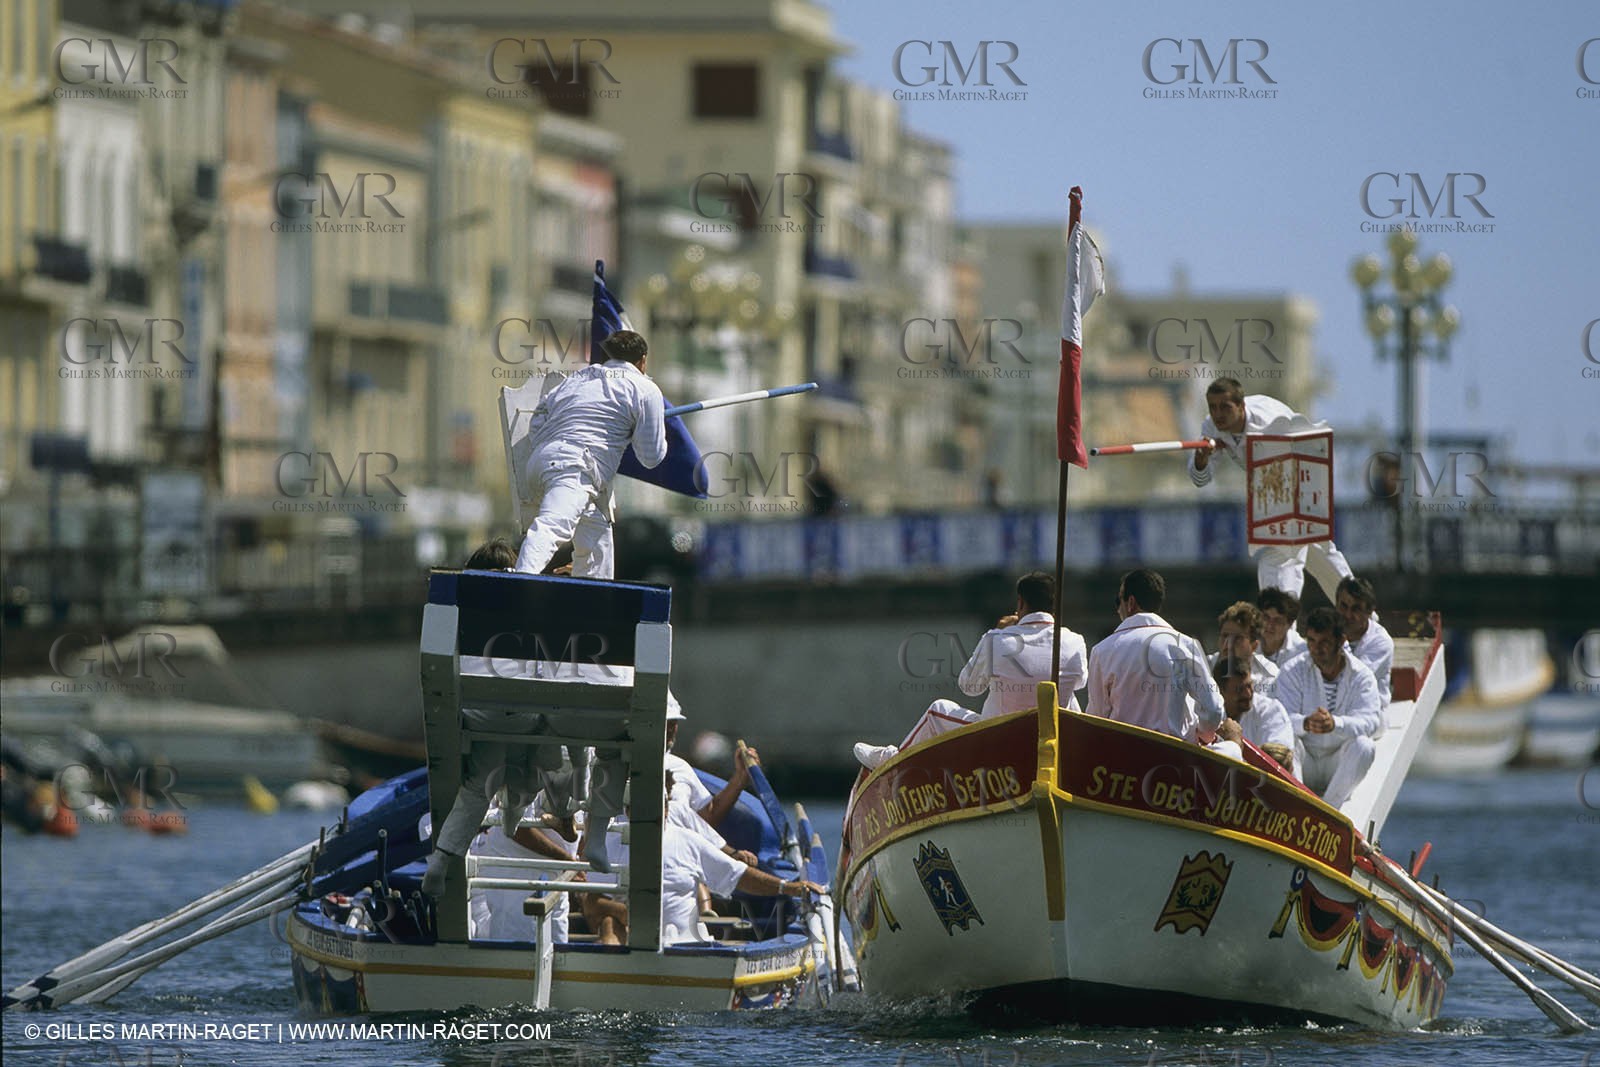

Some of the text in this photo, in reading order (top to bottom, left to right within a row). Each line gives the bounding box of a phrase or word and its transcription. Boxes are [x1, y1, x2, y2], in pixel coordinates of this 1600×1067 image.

[954, 766, 1020, 803] SETOIS
[1087, 766, 1137, 801] STE
[1151, 782, 1194, 814] DES
[1297, 816, 1342, 862] SETOIS
